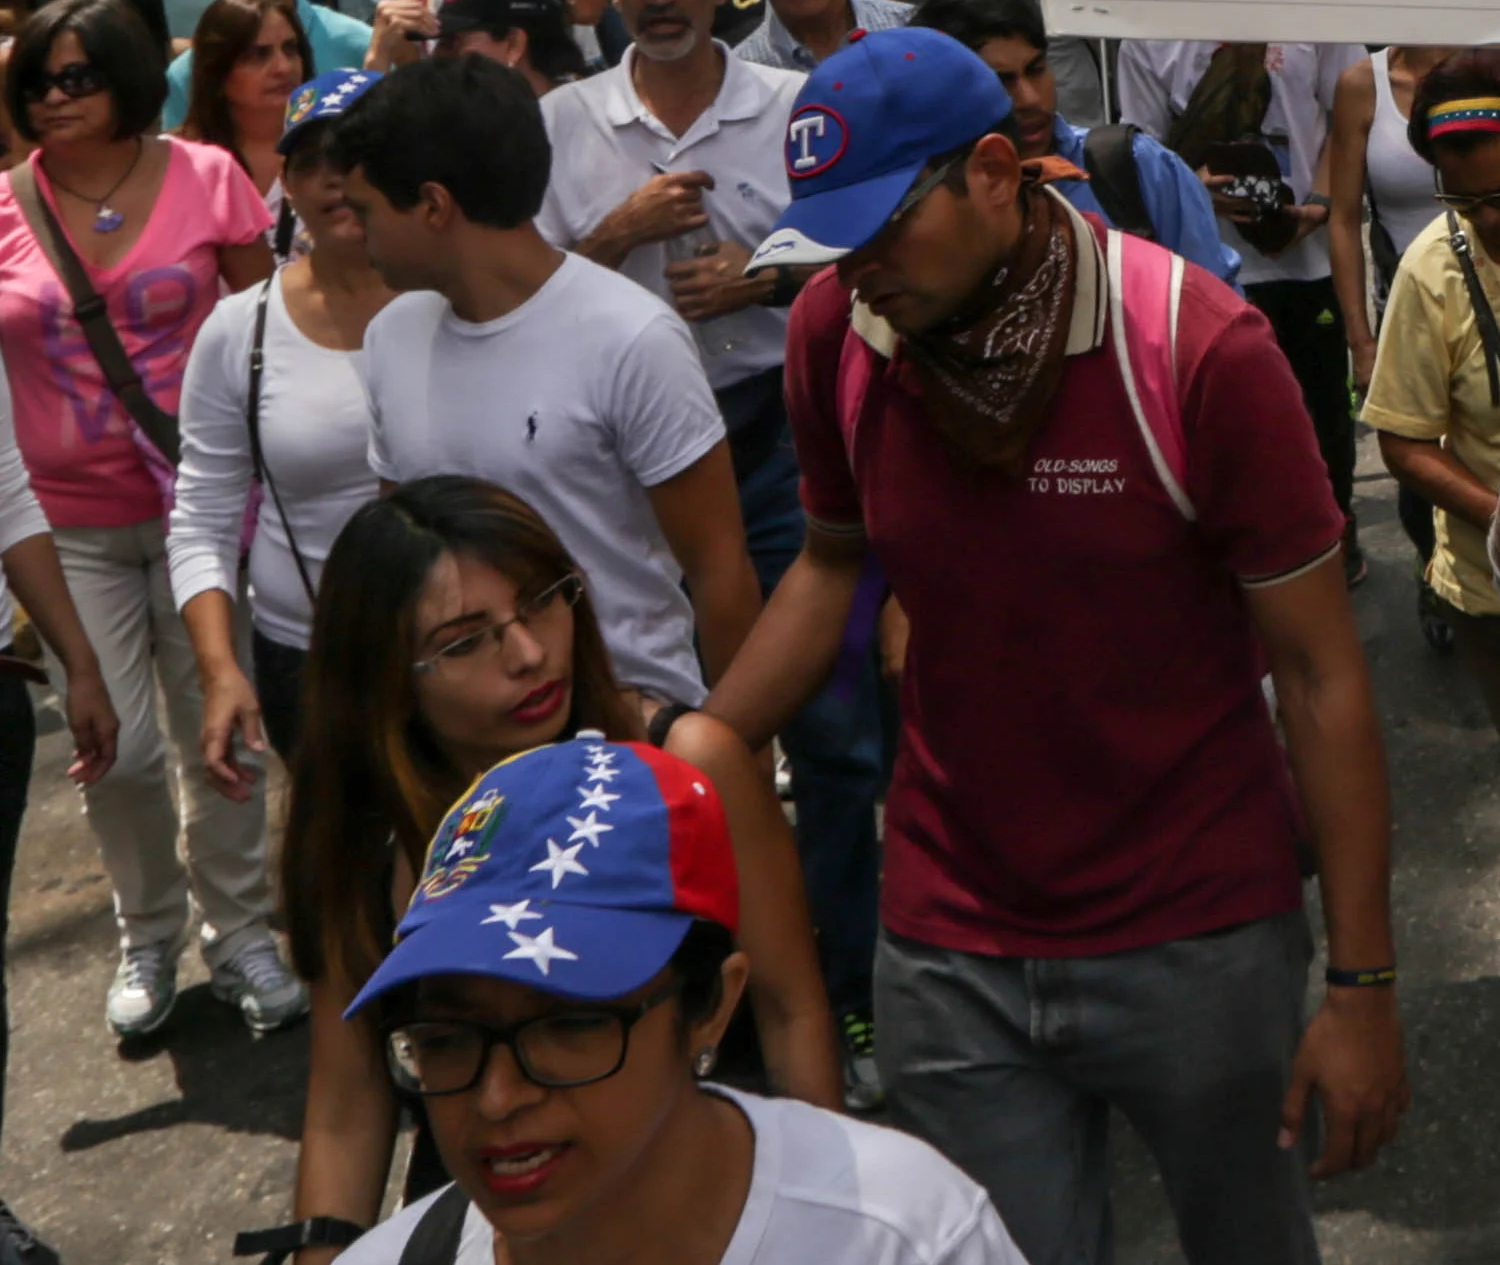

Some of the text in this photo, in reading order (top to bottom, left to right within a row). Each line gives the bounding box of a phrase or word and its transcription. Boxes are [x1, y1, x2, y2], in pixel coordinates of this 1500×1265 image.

[790, 115, 825, 170] T
[1028, 477, 1127, 495] TO DISPLAY
